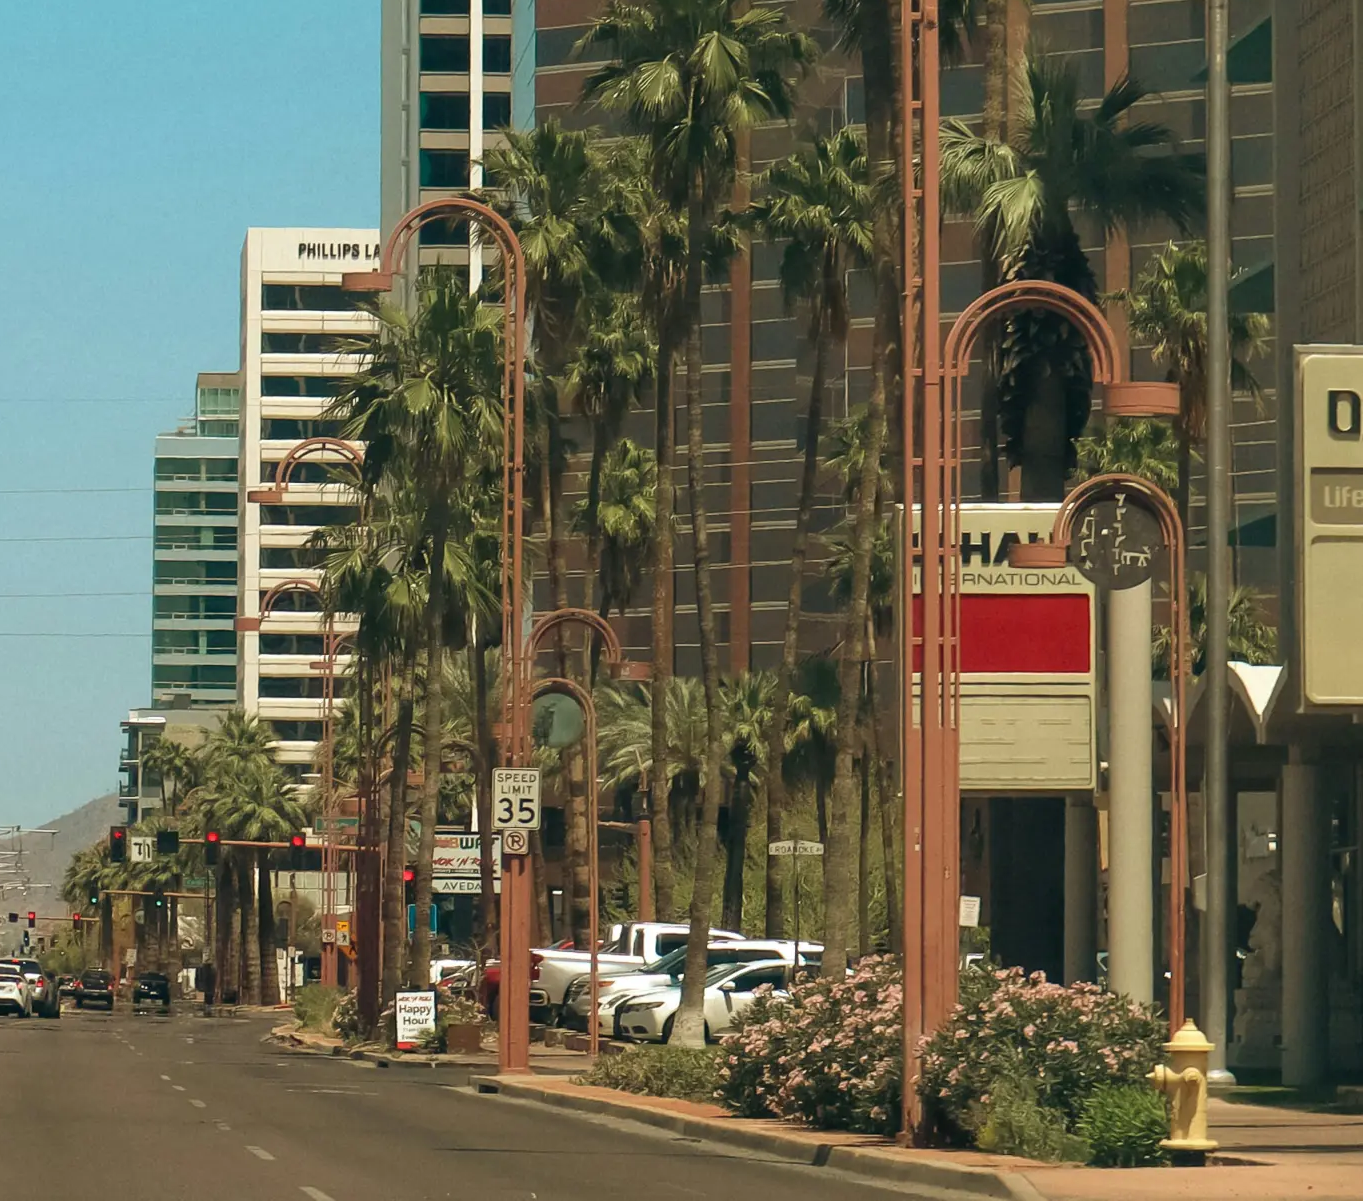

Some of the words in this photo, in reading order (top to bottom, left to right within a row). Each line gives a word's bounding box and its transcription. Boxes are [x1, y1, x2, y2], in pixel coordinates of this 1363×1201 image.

[298, 243, 360, 260] PHILLIPS
[914, 573, 1082, 586] IRNATIONAL
[497, 773, 537, 783] SPEED
[501, 785, 533, 795] LIMIT
[497, 797, 535, 824] 35
[442, 881, 483, 891] AVEDA
[399, 1004, 433, 1016] Happy
[403, 1015, 429, 1026] Hour
